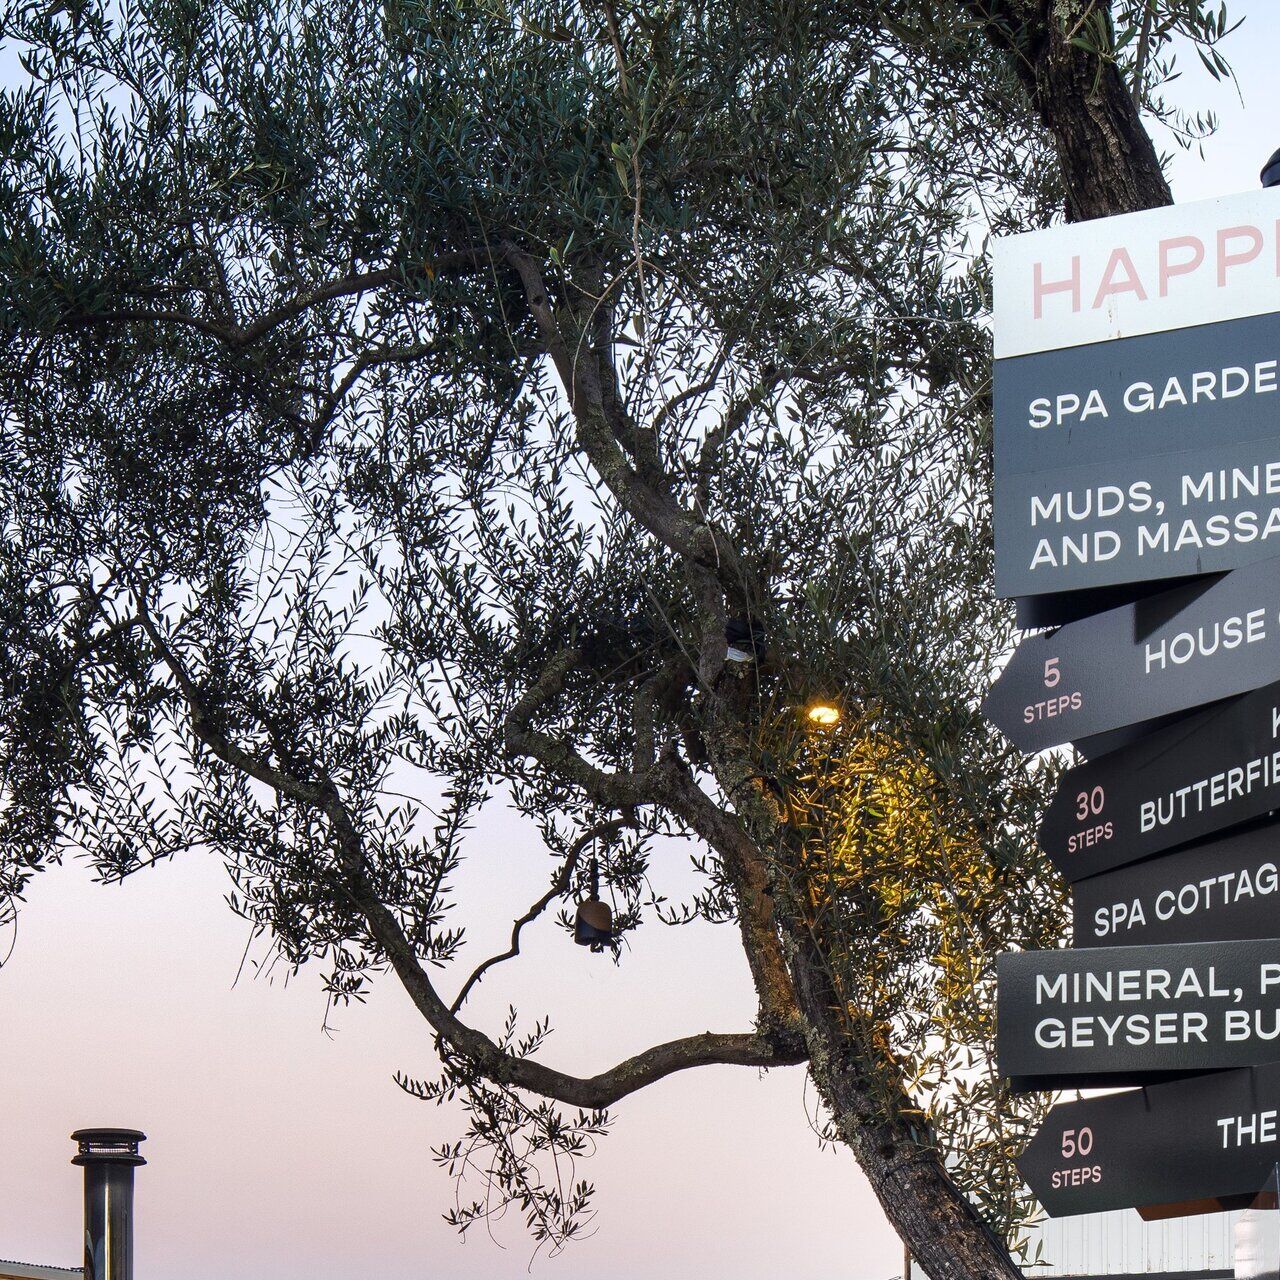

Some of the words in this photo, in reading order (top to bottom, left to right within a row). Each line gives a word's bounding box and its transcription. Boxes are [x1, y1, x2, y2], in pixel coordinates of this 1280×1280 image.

[1029, 390, 1108, 428] SPA
[1032, 482, 1164, 526] MUDS,
[1030, 531, 1121, 569] AND
[1146, 608, 1265, 673] HOUSE
[1045, 658, 1060, 687] 5
[1024, 692, 1081, 723] STEPS
[1077, 786, 1104, 820] 30
[1069, 822, 1113, 852] STEPS
[1095, 899, 1146, 936] SPA
[1037, 967, 1242, 1004] MINERAL,
[1035, 1013, 1207, 1048] GEYSER
[1062, 1127, 1092, 1158] 50
[1217, 1111, 1277, 1148] THE
[1052, 1166, 1101, 1188] STEPS
